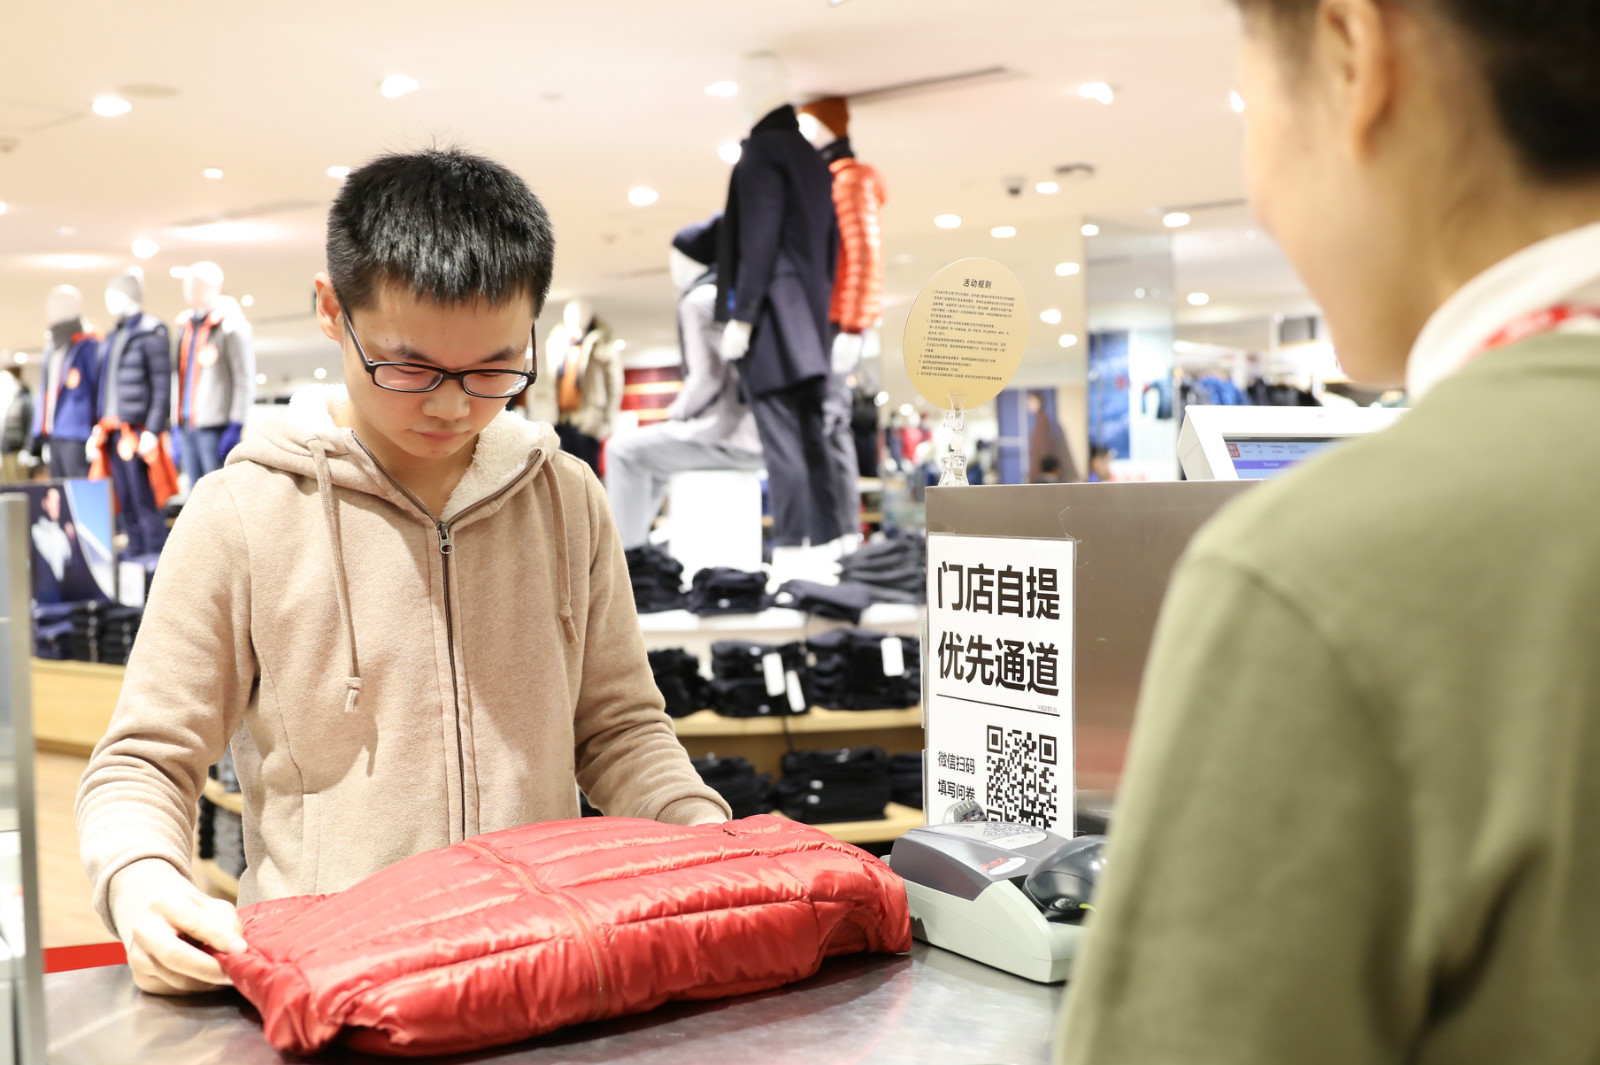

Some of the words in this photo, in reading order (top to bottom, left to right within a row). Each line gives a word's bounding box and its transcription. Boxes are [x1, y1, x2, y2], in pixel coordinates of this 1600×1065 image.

[963, 278, 992, 289] 活动规则
[938, 561, 1059, 620] 门店自提
[938, 631, 1058, 696] 优先通道
[937, 751, 976, 775] 微信扫码
[937, 778, 976, 803] 填写问卷
